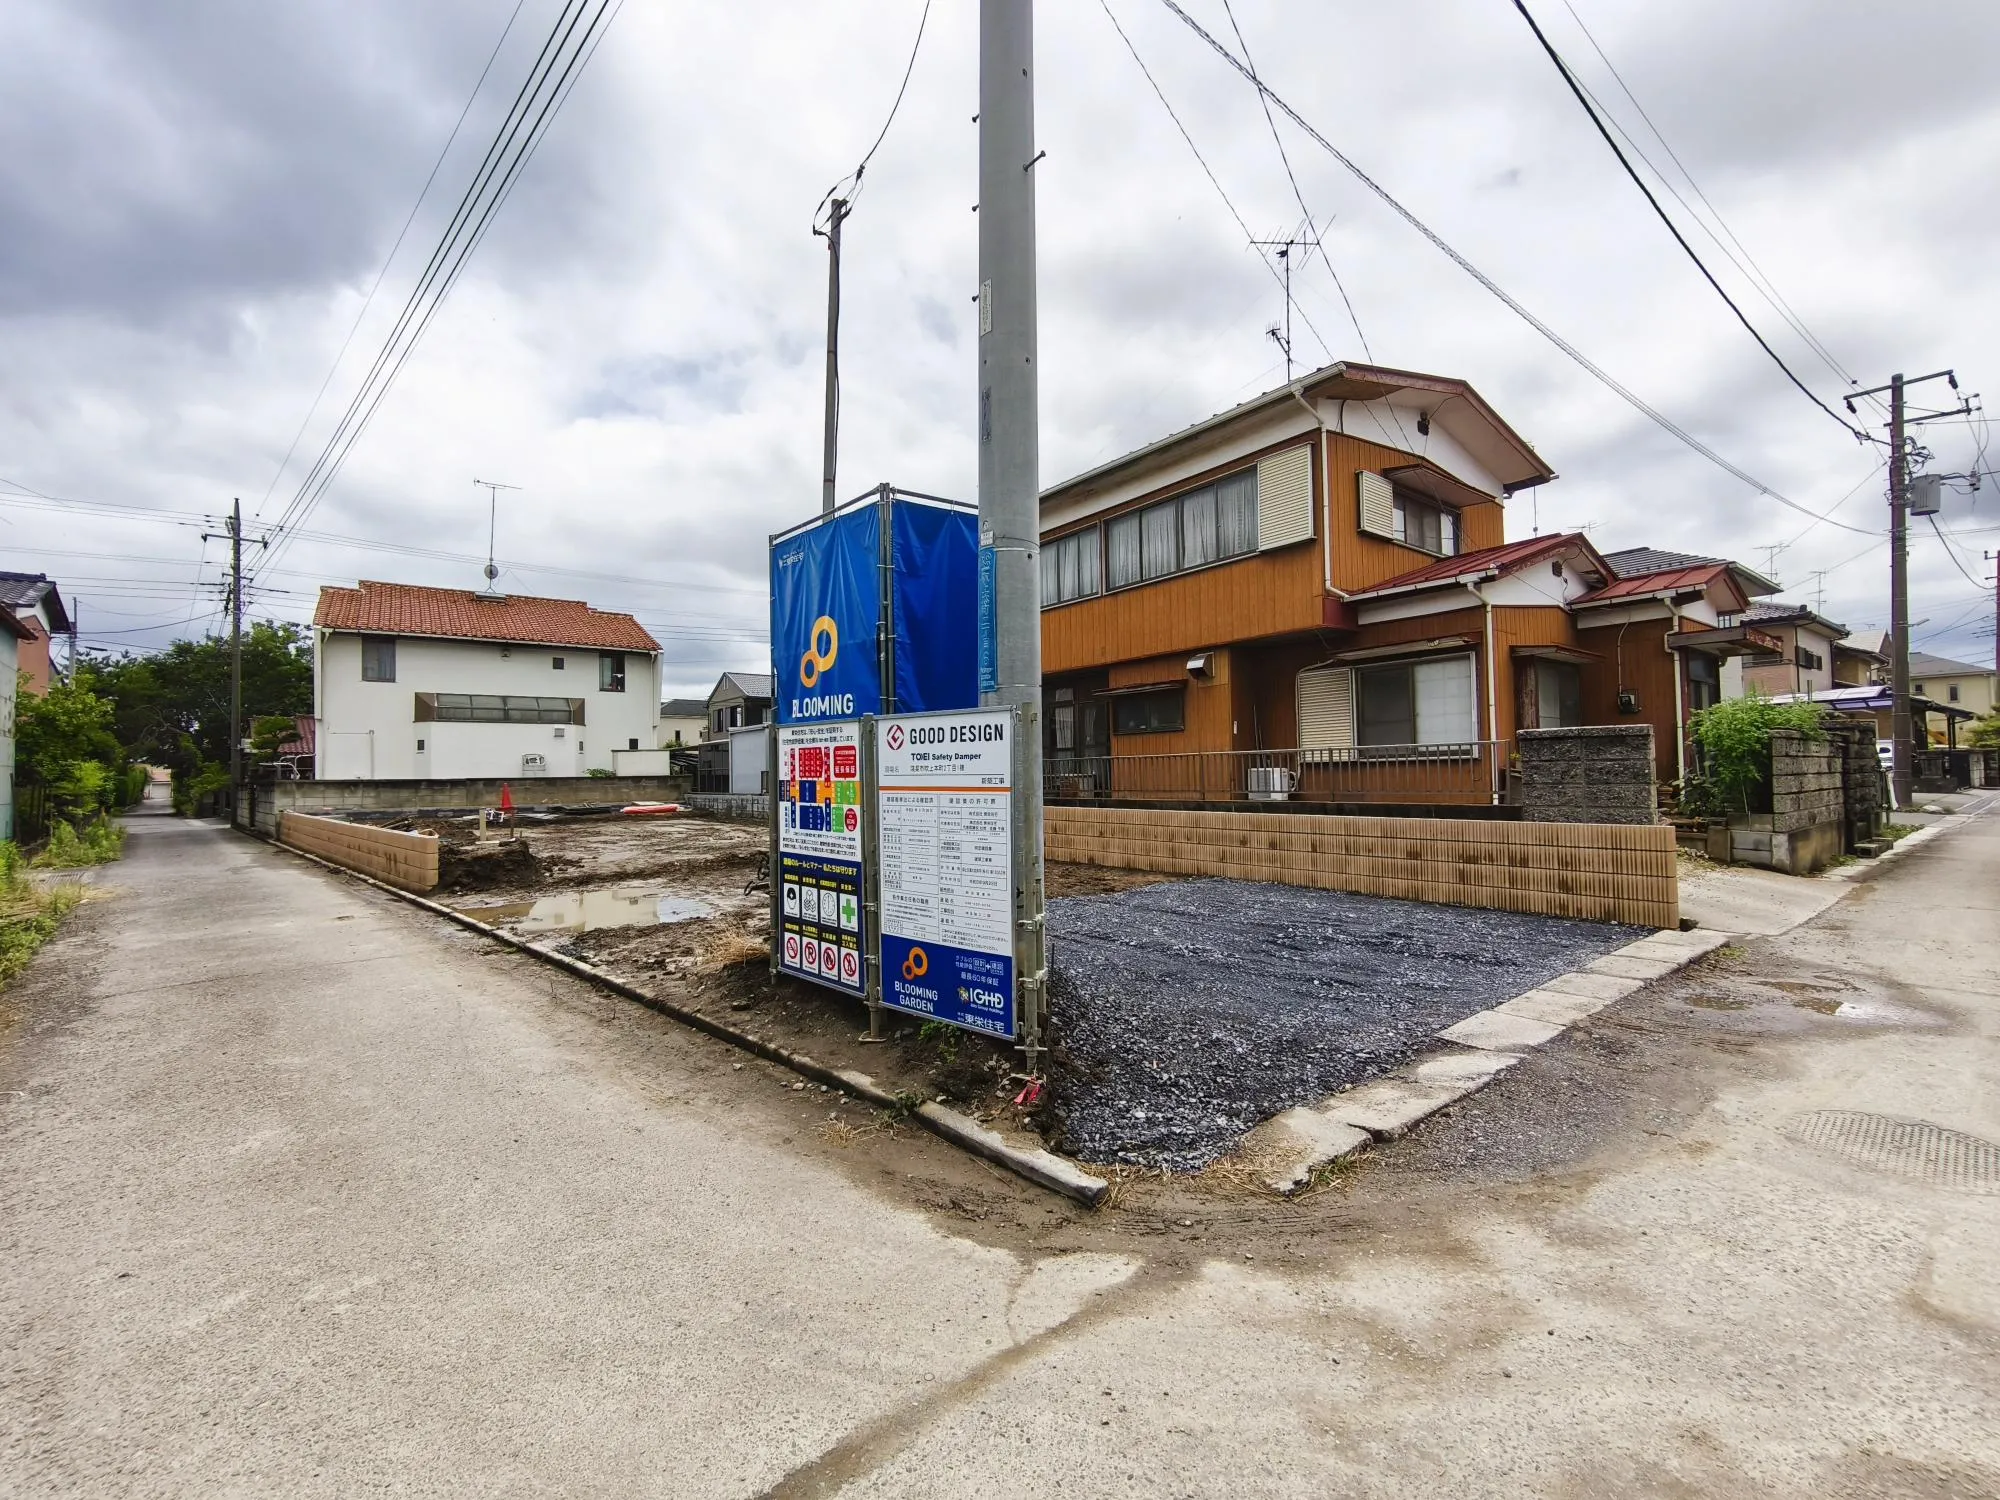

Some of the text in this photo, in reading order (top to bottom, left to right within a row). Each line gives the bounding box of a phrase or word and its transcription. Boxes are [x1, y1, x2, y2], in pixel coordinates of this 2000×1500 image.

[792, 693, 854, 718] BLOOMING
[909, 723, 1004, 745] GOOD DESIGN
[931, 753, 953, 762] Safety
[954, 752, 982, 762] Damper
[981, 777, 1005, 785] 新築工事
[894, 980, 938, 1001] BLOOMING
[899, 994, 934, 1013] GARDEN
[964, 1013, 1005, 1033] 東栄住宅
